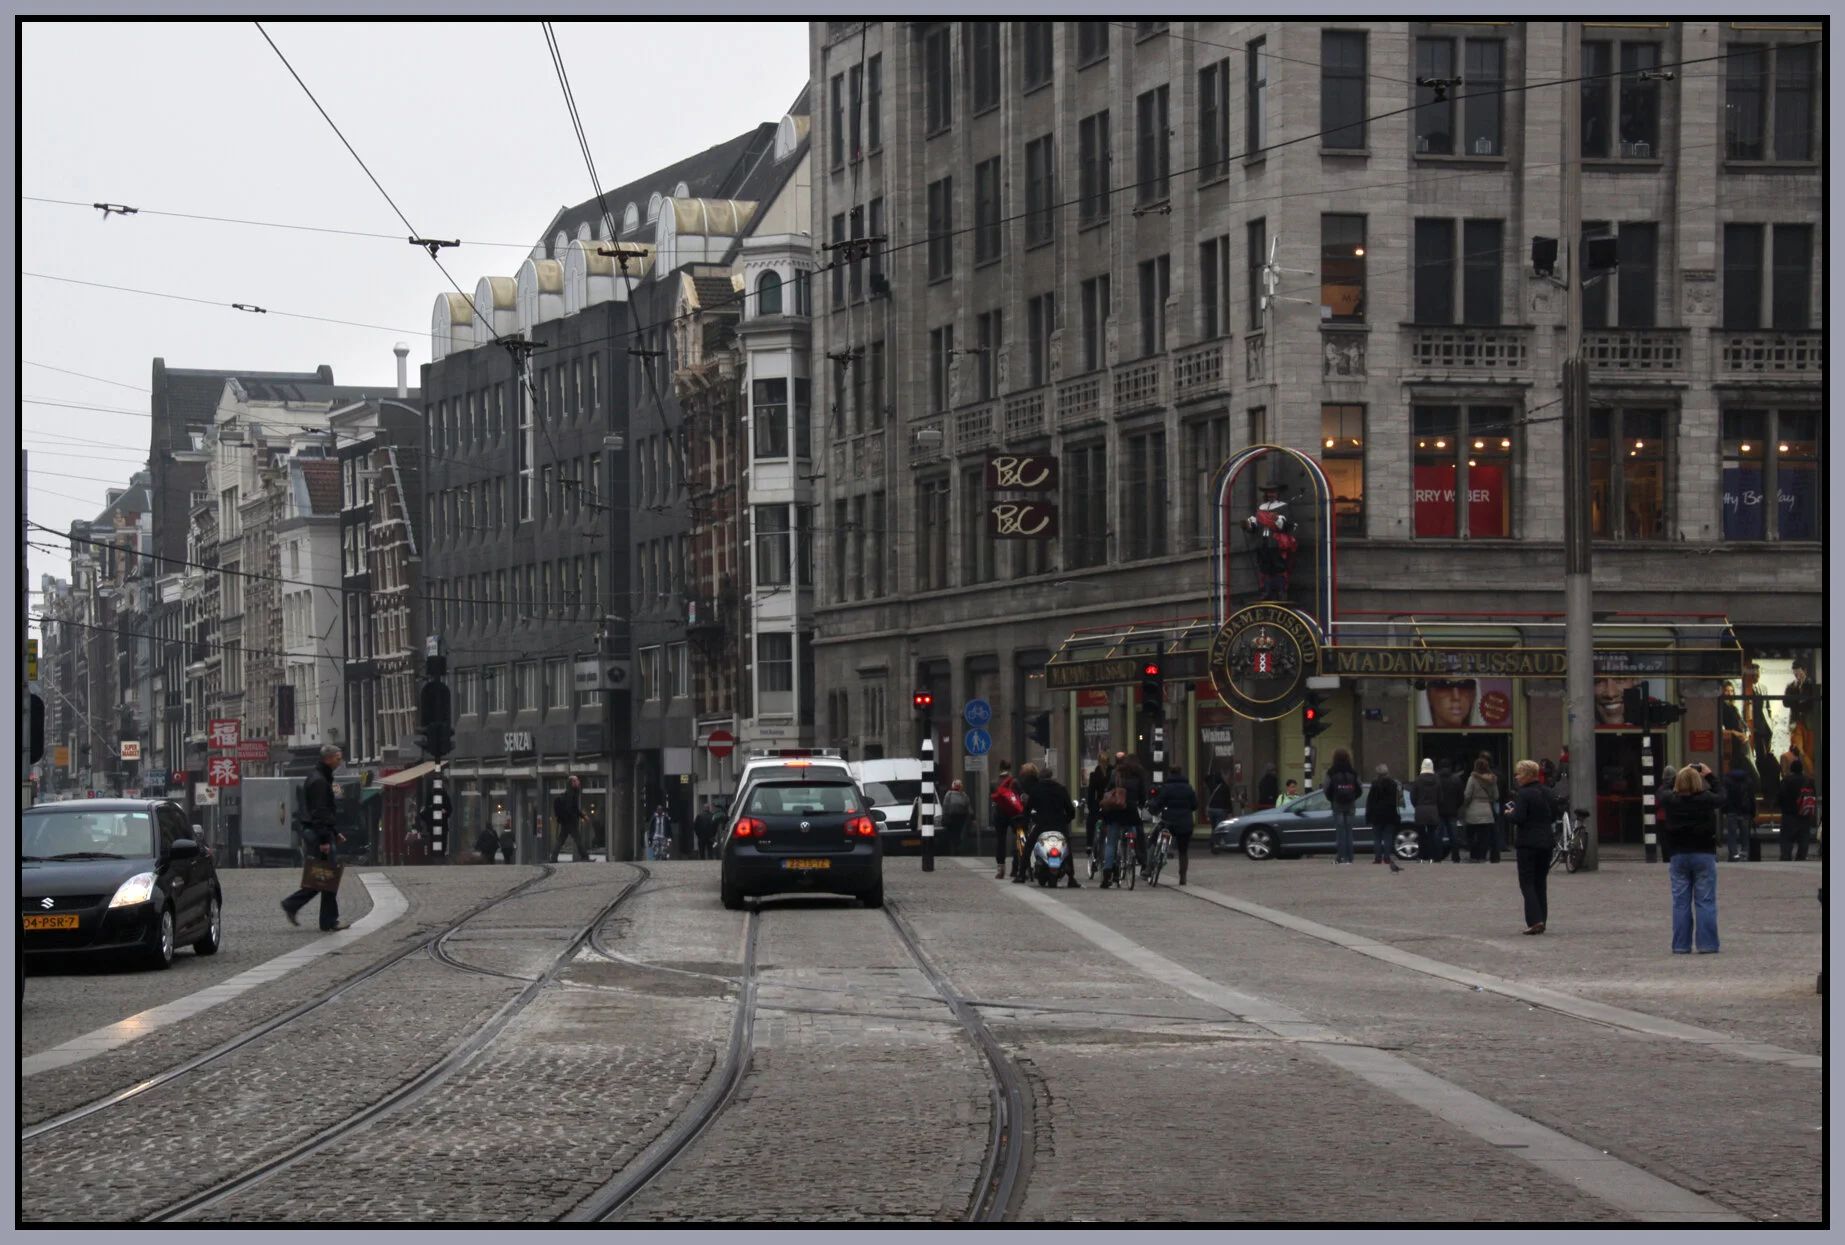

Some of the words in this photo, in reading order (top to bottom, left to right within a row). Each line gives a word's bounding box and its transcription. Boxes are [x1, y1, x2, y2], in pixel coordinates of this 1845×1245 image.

[992, 456, 1049, 487] P&C
[992, 505, 1049, 534] P&C
[1212, 609, 1265, 666] MADAME
[1267, 609, 1315, 663] TUSSAUD
[1338, 652, 1446, 673] MADAME
[1458, 652, 1568, 674] TUSSAUD
[209, 722, 238, 747] 福
[504, 732, 532, 751] SENZA
